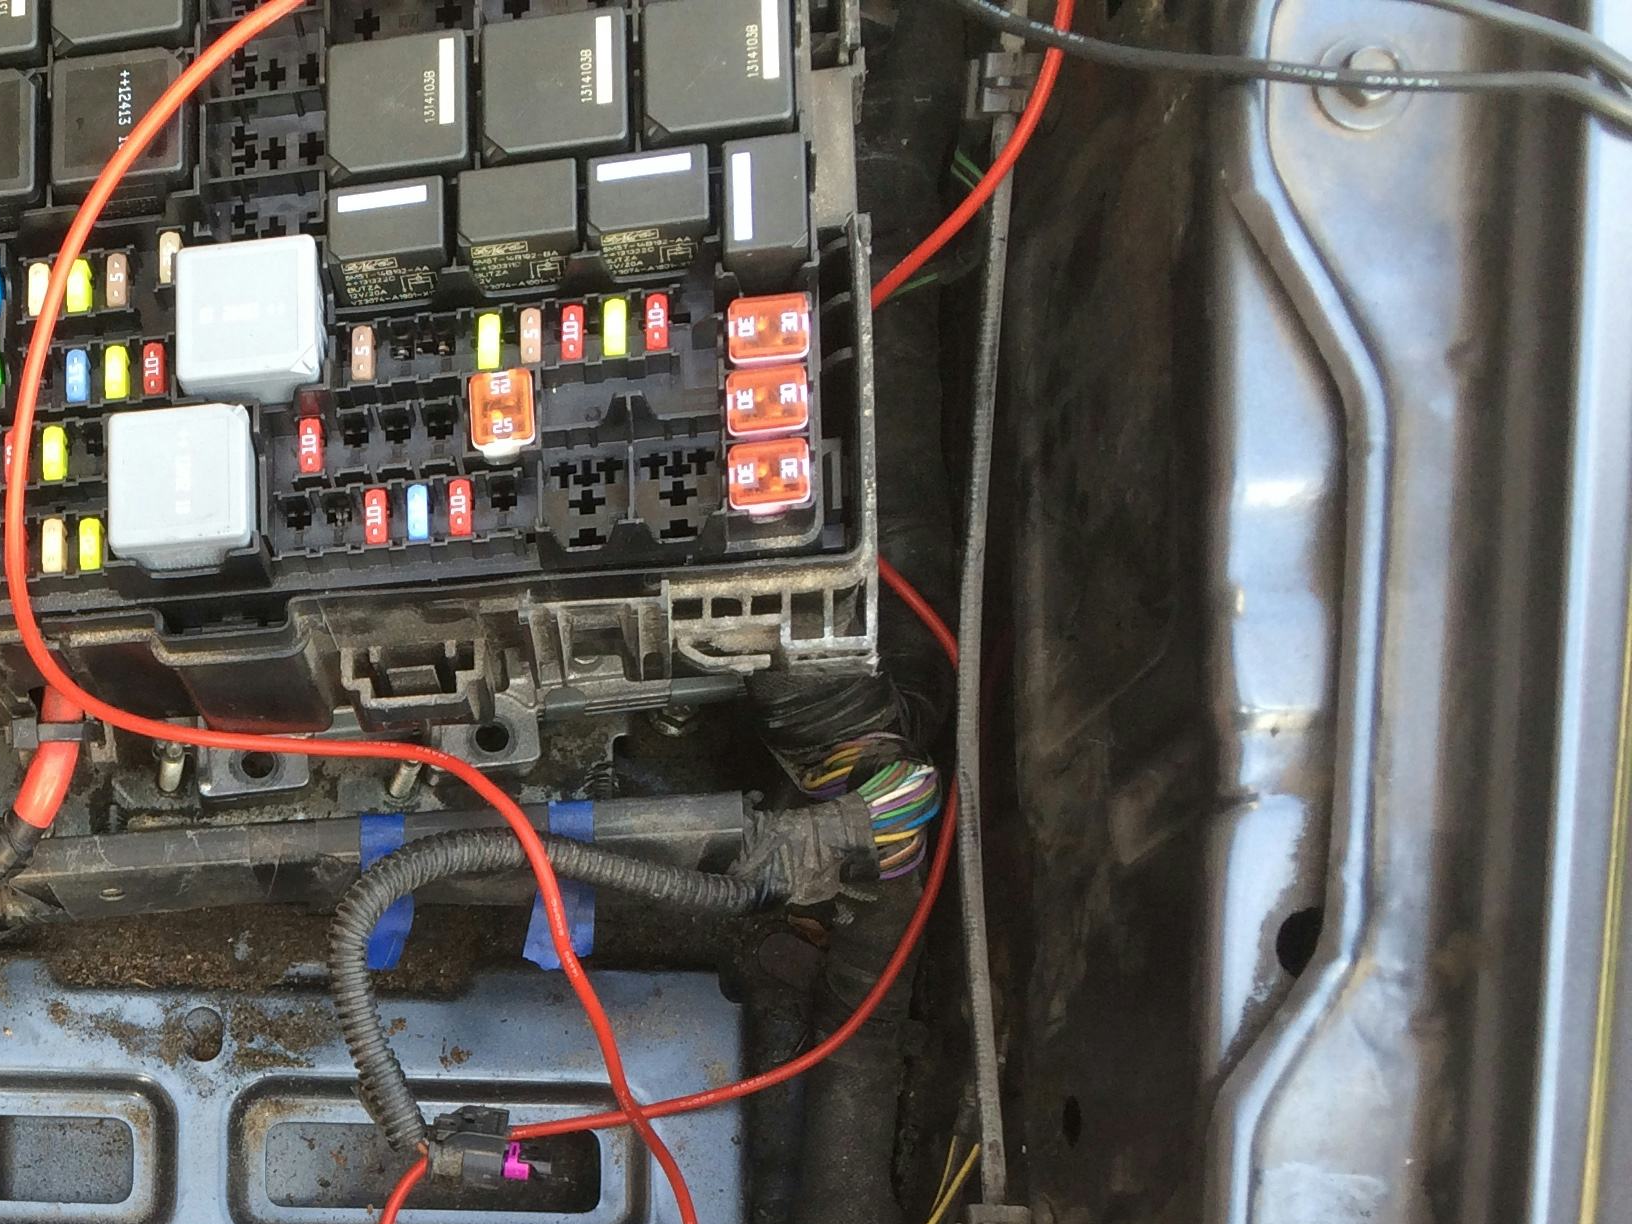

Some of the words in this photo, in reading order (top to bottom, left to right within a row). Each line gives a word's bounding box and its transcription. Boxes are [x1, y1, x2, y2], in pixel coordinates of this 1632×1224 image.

[118, 136, 129, 150] 1
[109, 272, 124, 283] 5
[647, 307, 665, 329] 10
[737, 317, 755, 337] 30
[781, 311, 799, 332] 30
[523, 328, 539, 340] 5
[563, 321, 579, 343] 10
[354, 345, 370, 356] 5
[144, 358, 160, 377] 10
[489, 378, 511, 394] 25
[780, 382, 797, 404] 30
[736, 389, 753, 410] 30
[491, 417, 513, 434] 25
[301, 434, 317, 455] 10
[737, 464, 755, 484] 30
[781, 457, 799, 479] 30
[449, 495, 466, 516] 10
[366, 506, 382, 527] 10
